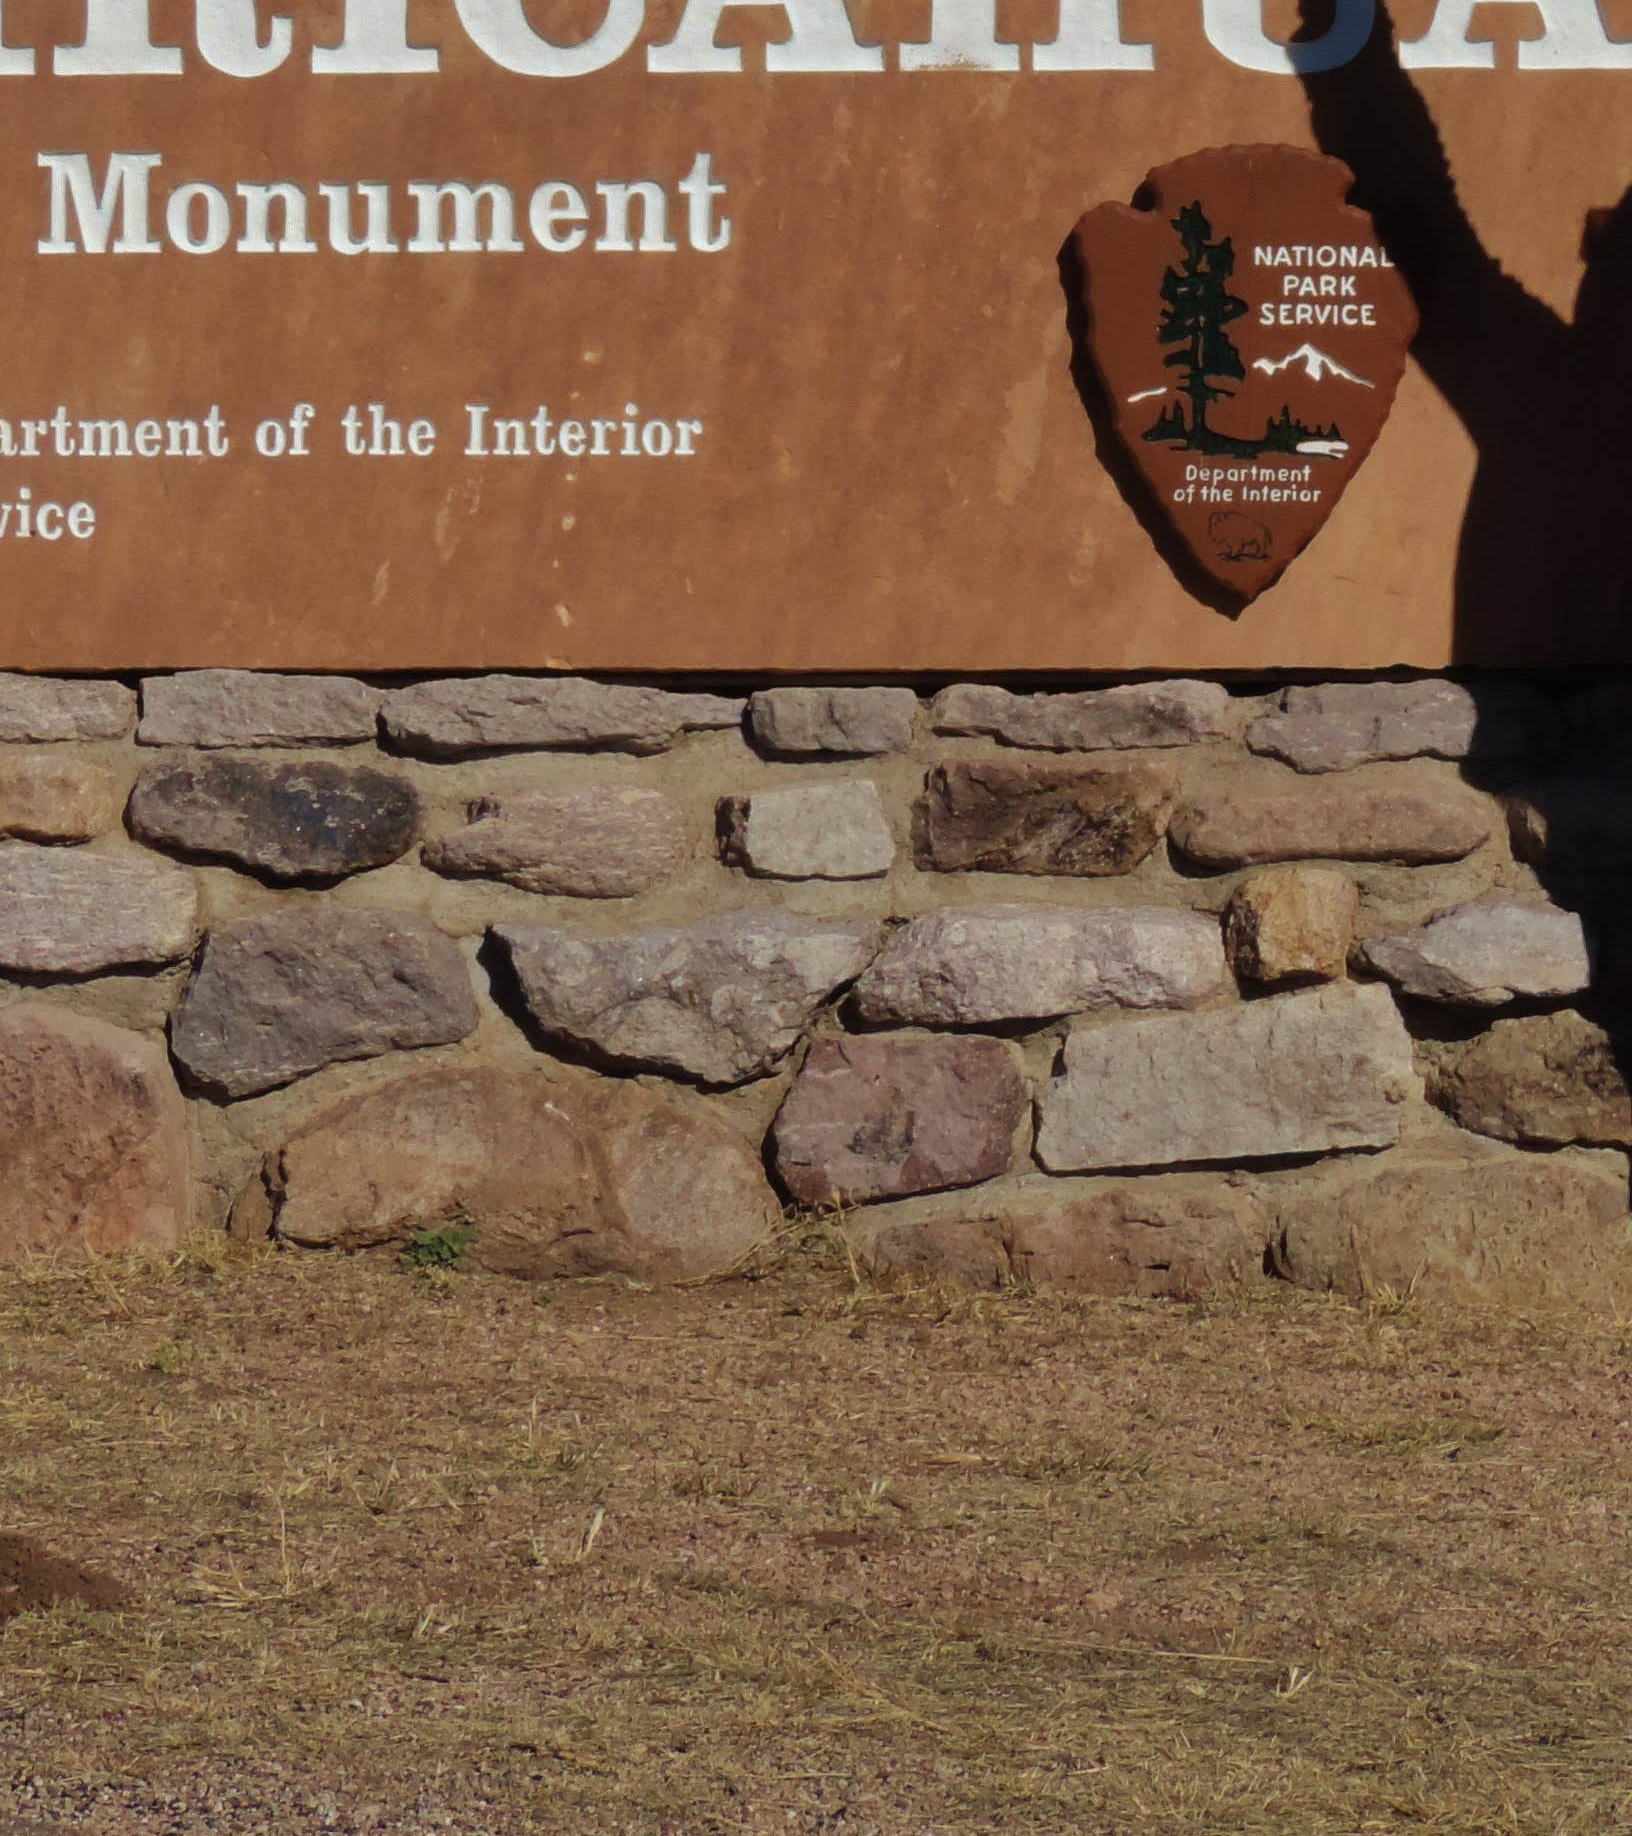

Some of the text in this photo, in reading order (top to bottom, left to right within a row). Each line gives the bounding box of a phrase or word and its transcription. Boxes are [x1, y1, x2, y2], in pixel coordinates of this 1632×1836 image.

[37, 152, 731, 256] Monument
[1254, 245, 1395, 268] NATIONAL
[1283, 274, 1357, 297] PARK
[1259, 302, 1377, 326] SERVICE
[254, 403, 316, 458] of
[340, 403, 436, 458] the
[463, 402, 704, 458] Interior
[1184, 464, 1312, 488] Department
[1173, 483, 1322, 504] of the Interior
